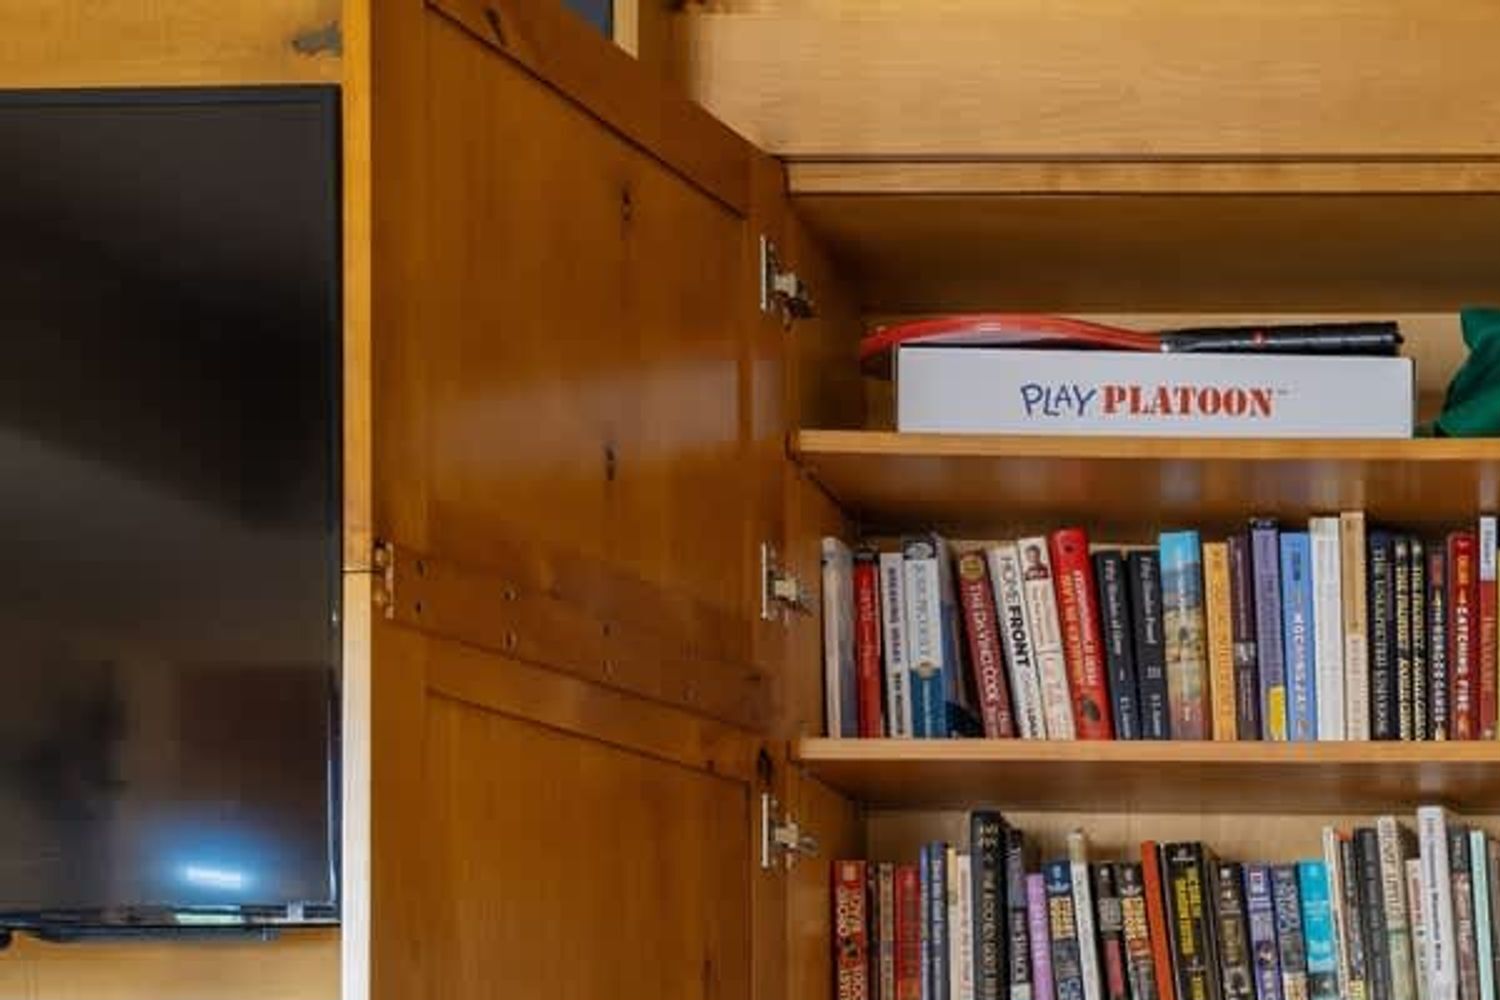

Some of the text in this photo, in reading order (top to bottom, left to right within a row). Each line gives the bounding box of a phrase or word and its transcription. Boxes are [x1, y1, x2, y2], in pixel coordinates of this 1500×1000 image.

[1020, 384, 1274, 417] PLAY PLATOON
[1001, 557, 1031, 667] HOME FRONT
[1457, 607, 1469, 712] CATCHING FIRE
